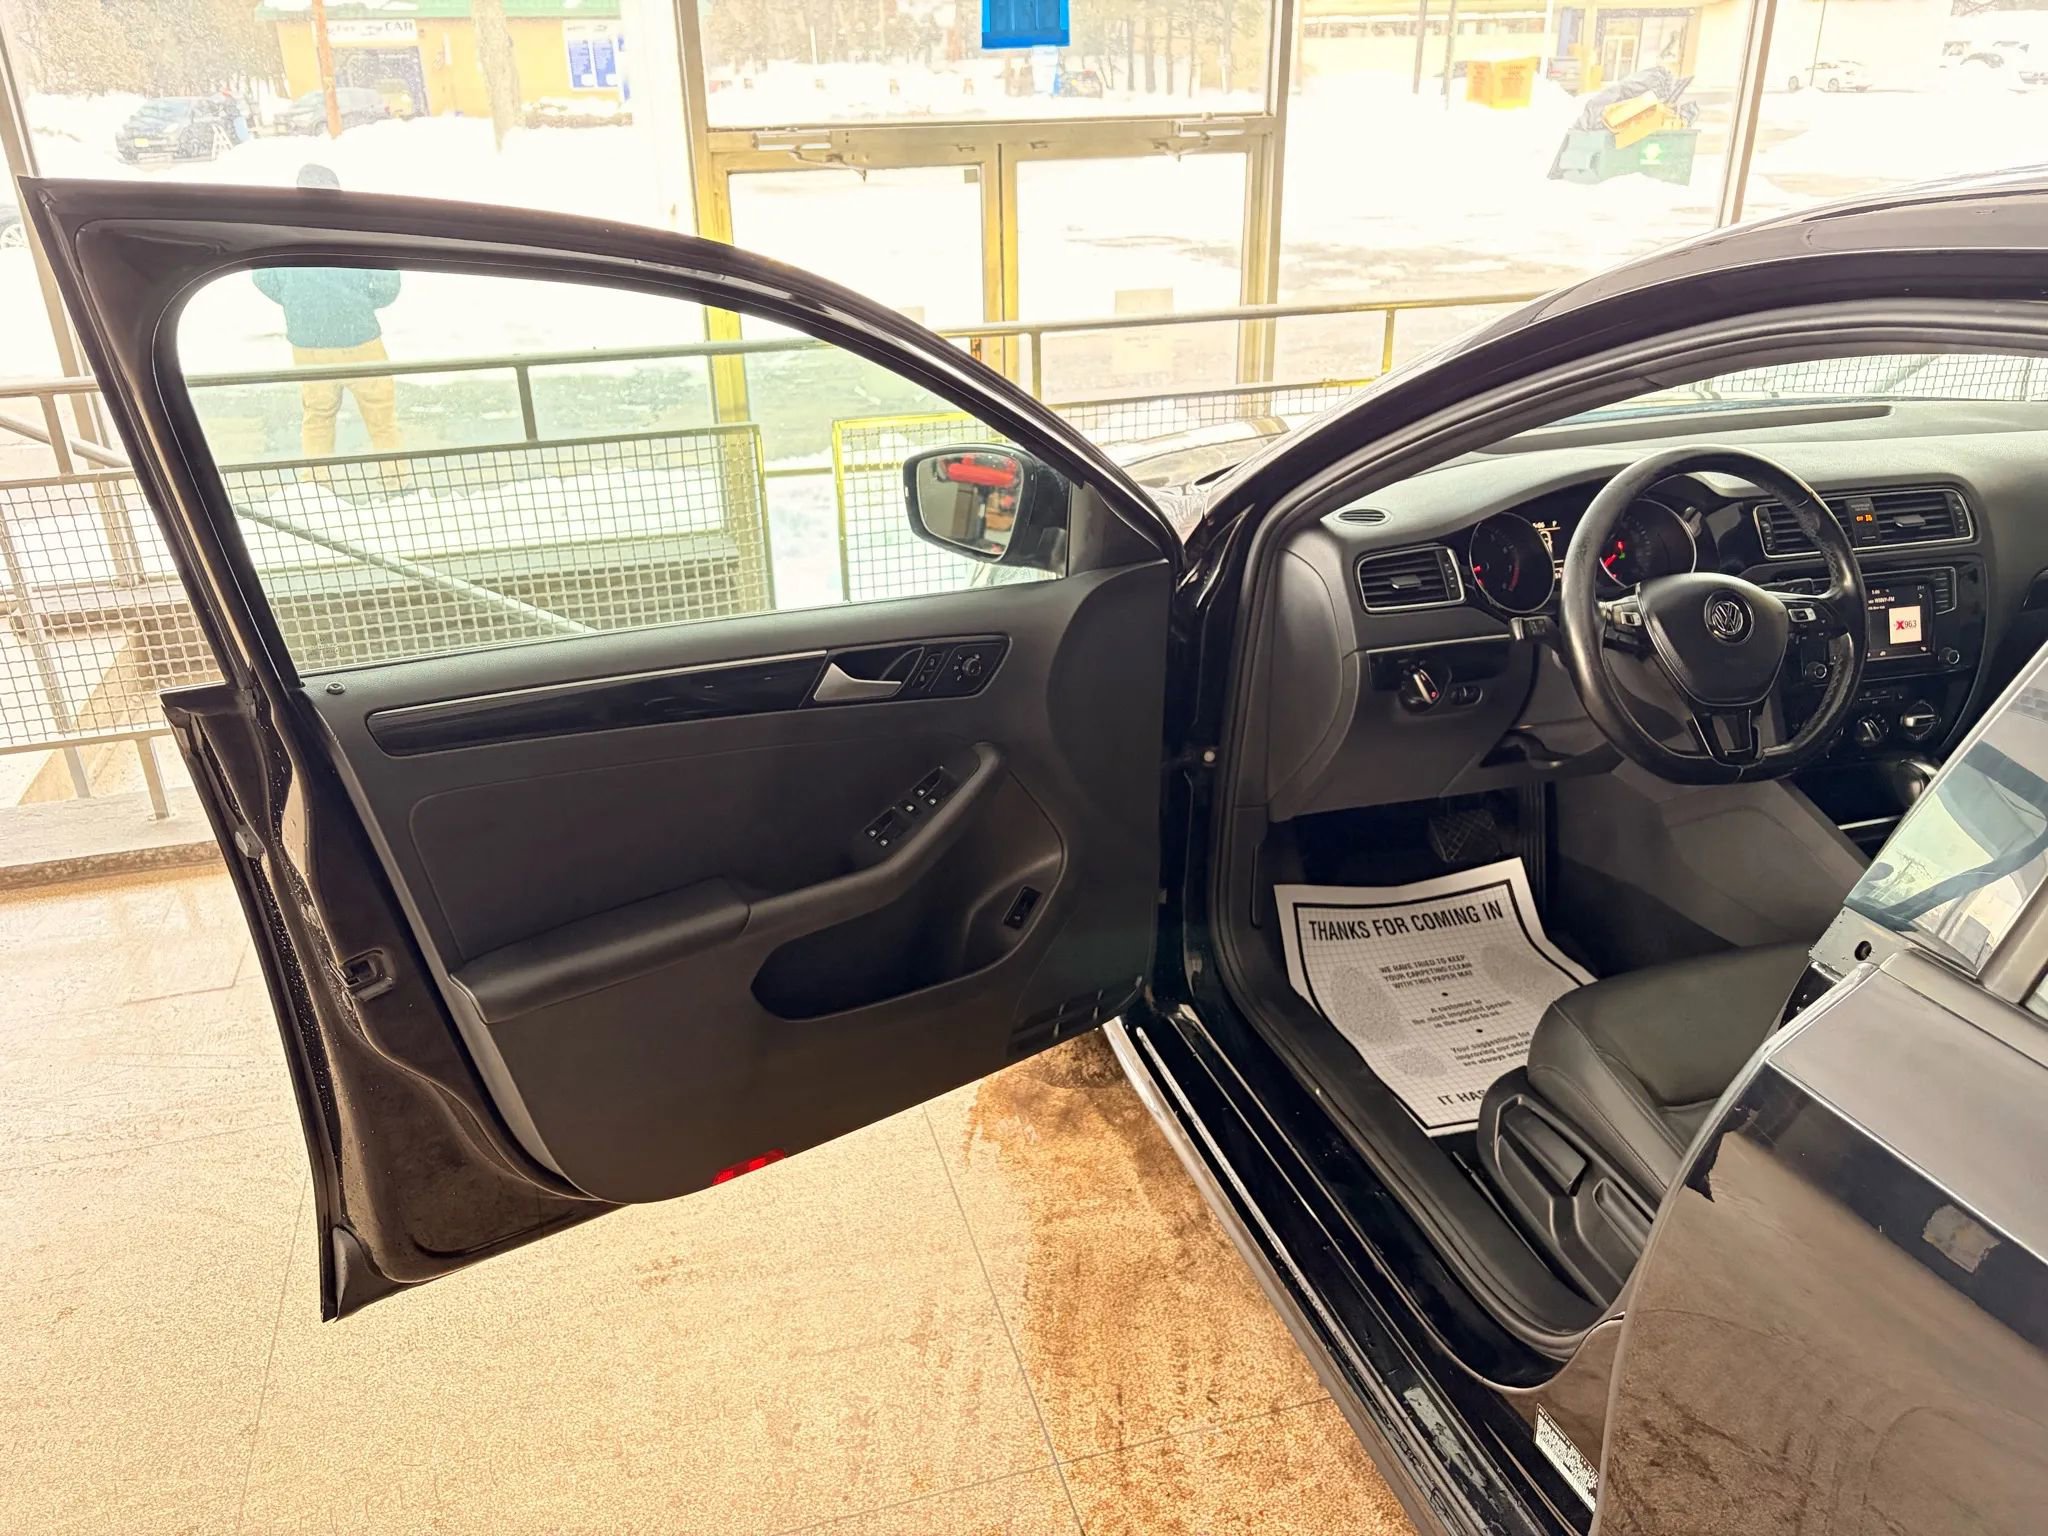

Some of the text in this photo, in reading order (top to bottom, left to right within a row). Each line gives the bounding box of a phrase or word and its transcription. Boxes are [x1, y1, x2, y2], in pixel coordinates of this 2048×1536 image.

[1309, 900, 1504, 942] THANKS FOR COMING IN
[1437, 1094, 1454, 1106] IT
